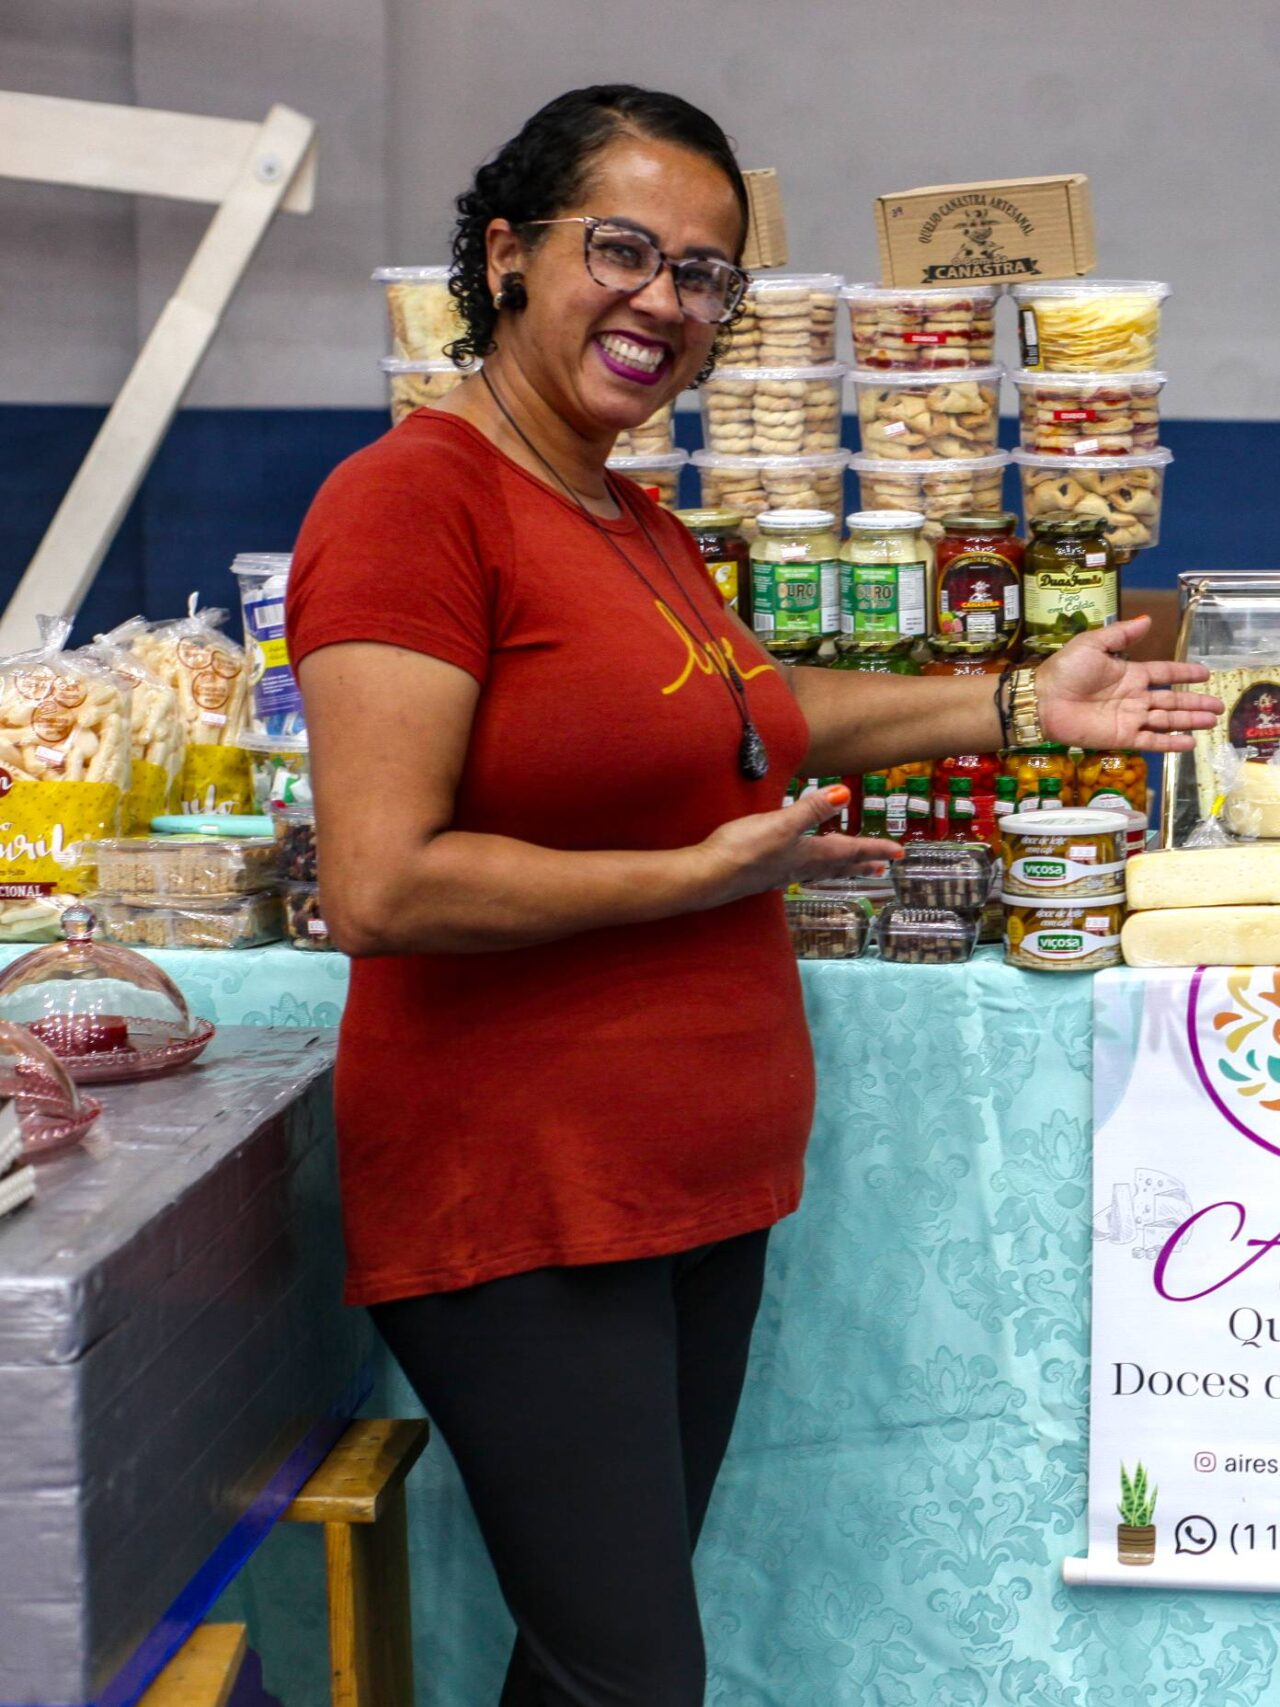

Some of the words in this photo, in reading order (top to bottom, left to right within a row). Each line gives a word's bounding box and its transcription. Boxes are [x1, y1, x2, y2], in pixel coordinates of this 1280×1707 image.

[939, 194, 986, 216] CANASTRA
[989, 197, 1035, 237] ARTESANAL
[934, 261, 1026, 279] CANASTRA
[1040, 574, 1070, 587] Duas
[1026, 864, 1063, 876] viçosa
[0, 883, 43, 896] CIONAL
[1040, 938, 1080, 949] viçosa
[1112, 1362, 1250, 1399] Doces
